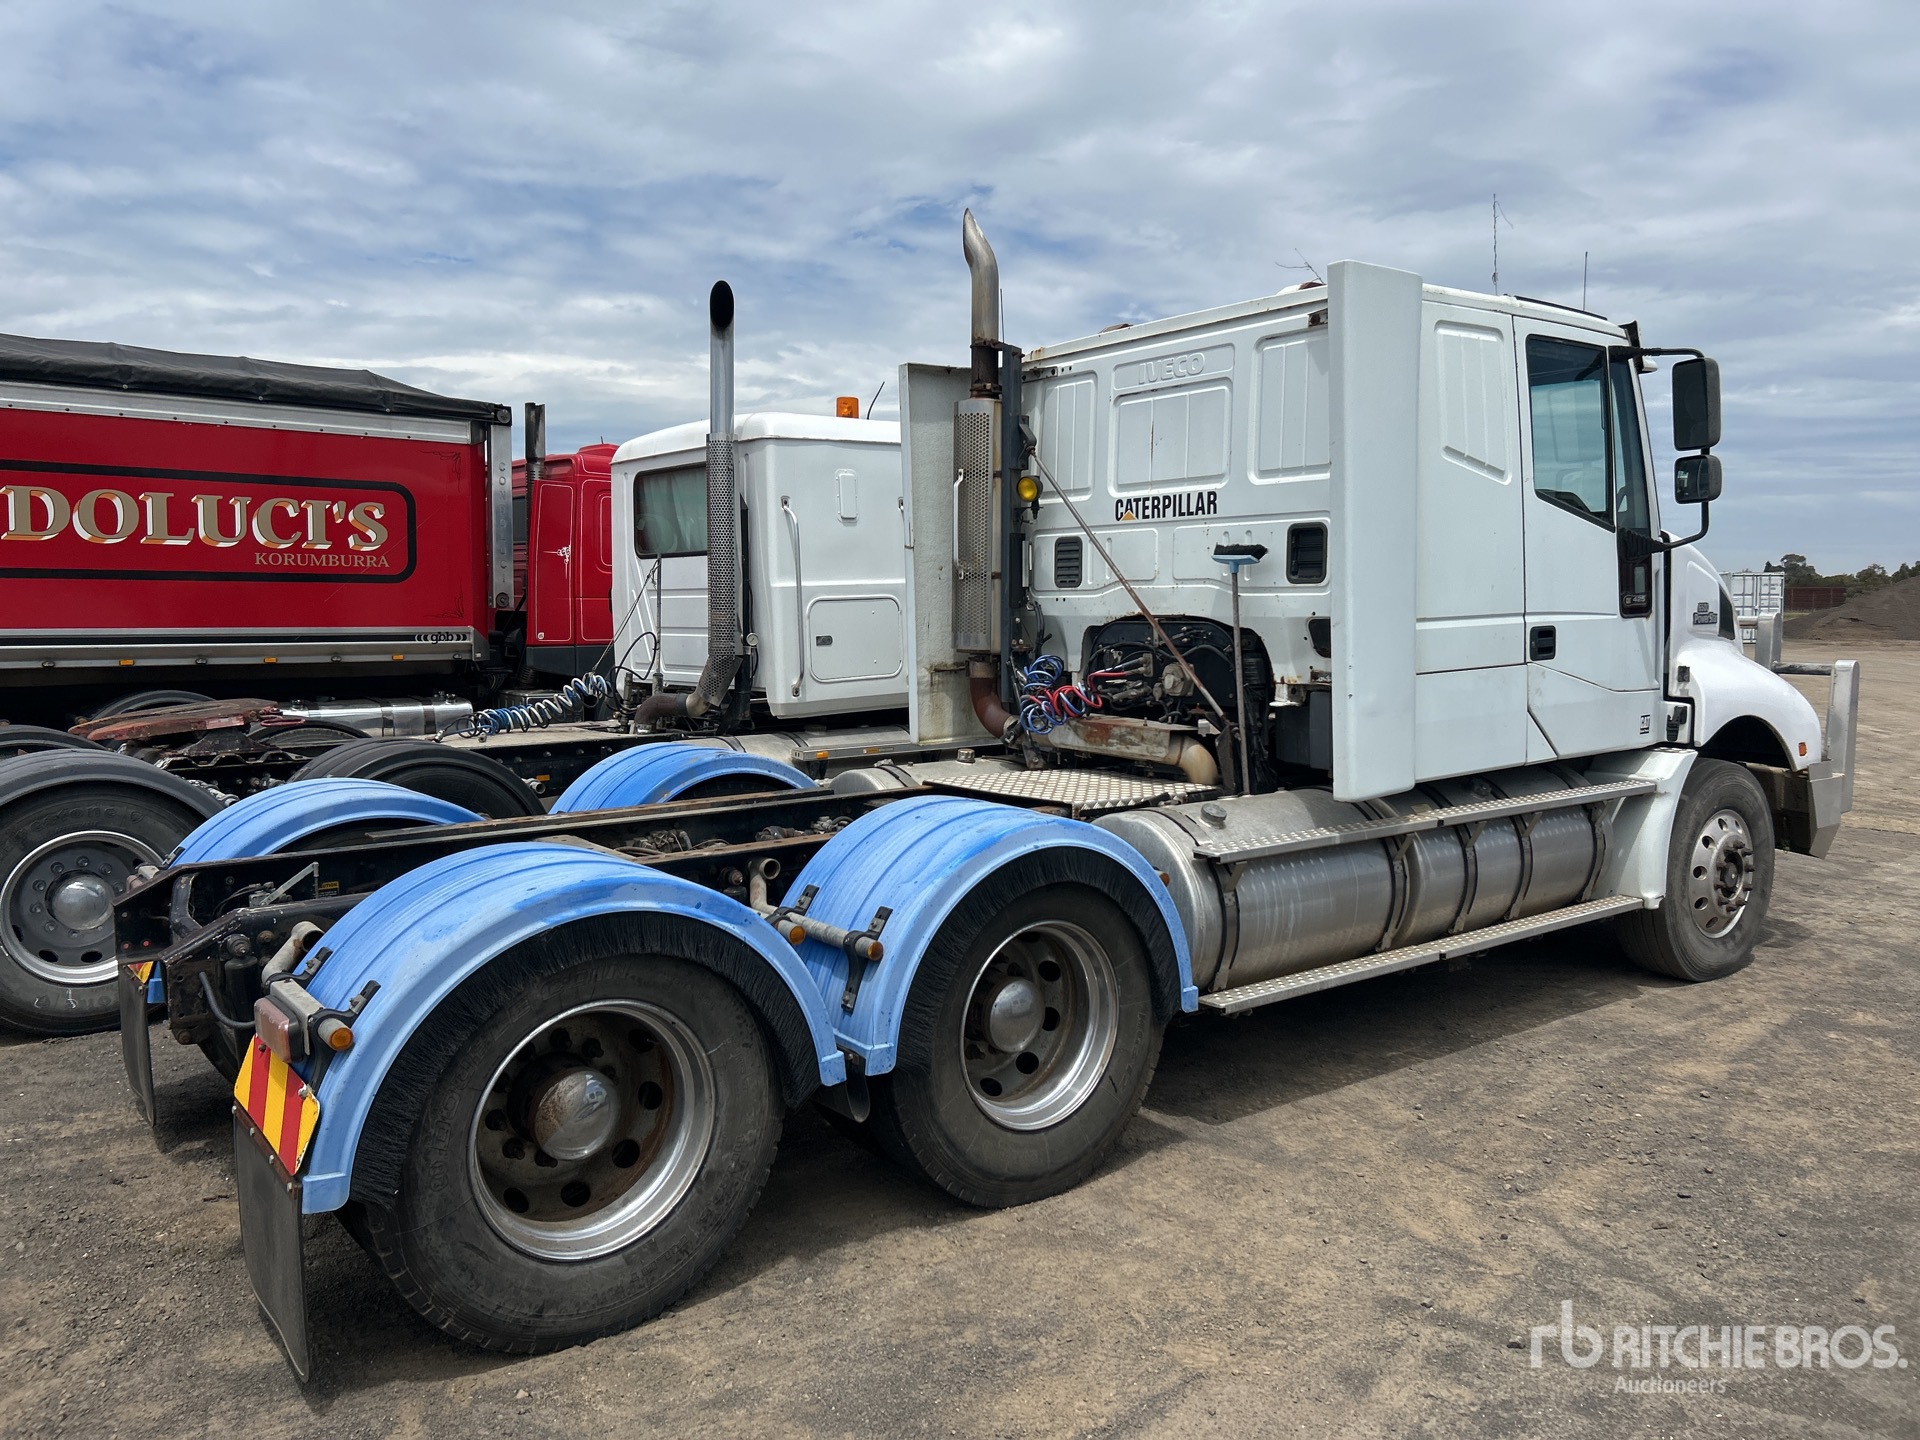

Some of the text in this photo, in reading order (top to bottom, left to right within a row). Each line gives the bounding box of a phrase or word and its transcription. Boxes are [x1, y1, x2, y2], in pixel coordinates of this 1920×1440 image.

[1138, 352, 1206, 385] IVECO
[0, 484, 387, 551] DOLUCI'S
[1114, 490, 1218, 522] CATERPILLAR
[254, 551, 390, 568] KORUMBURRA
